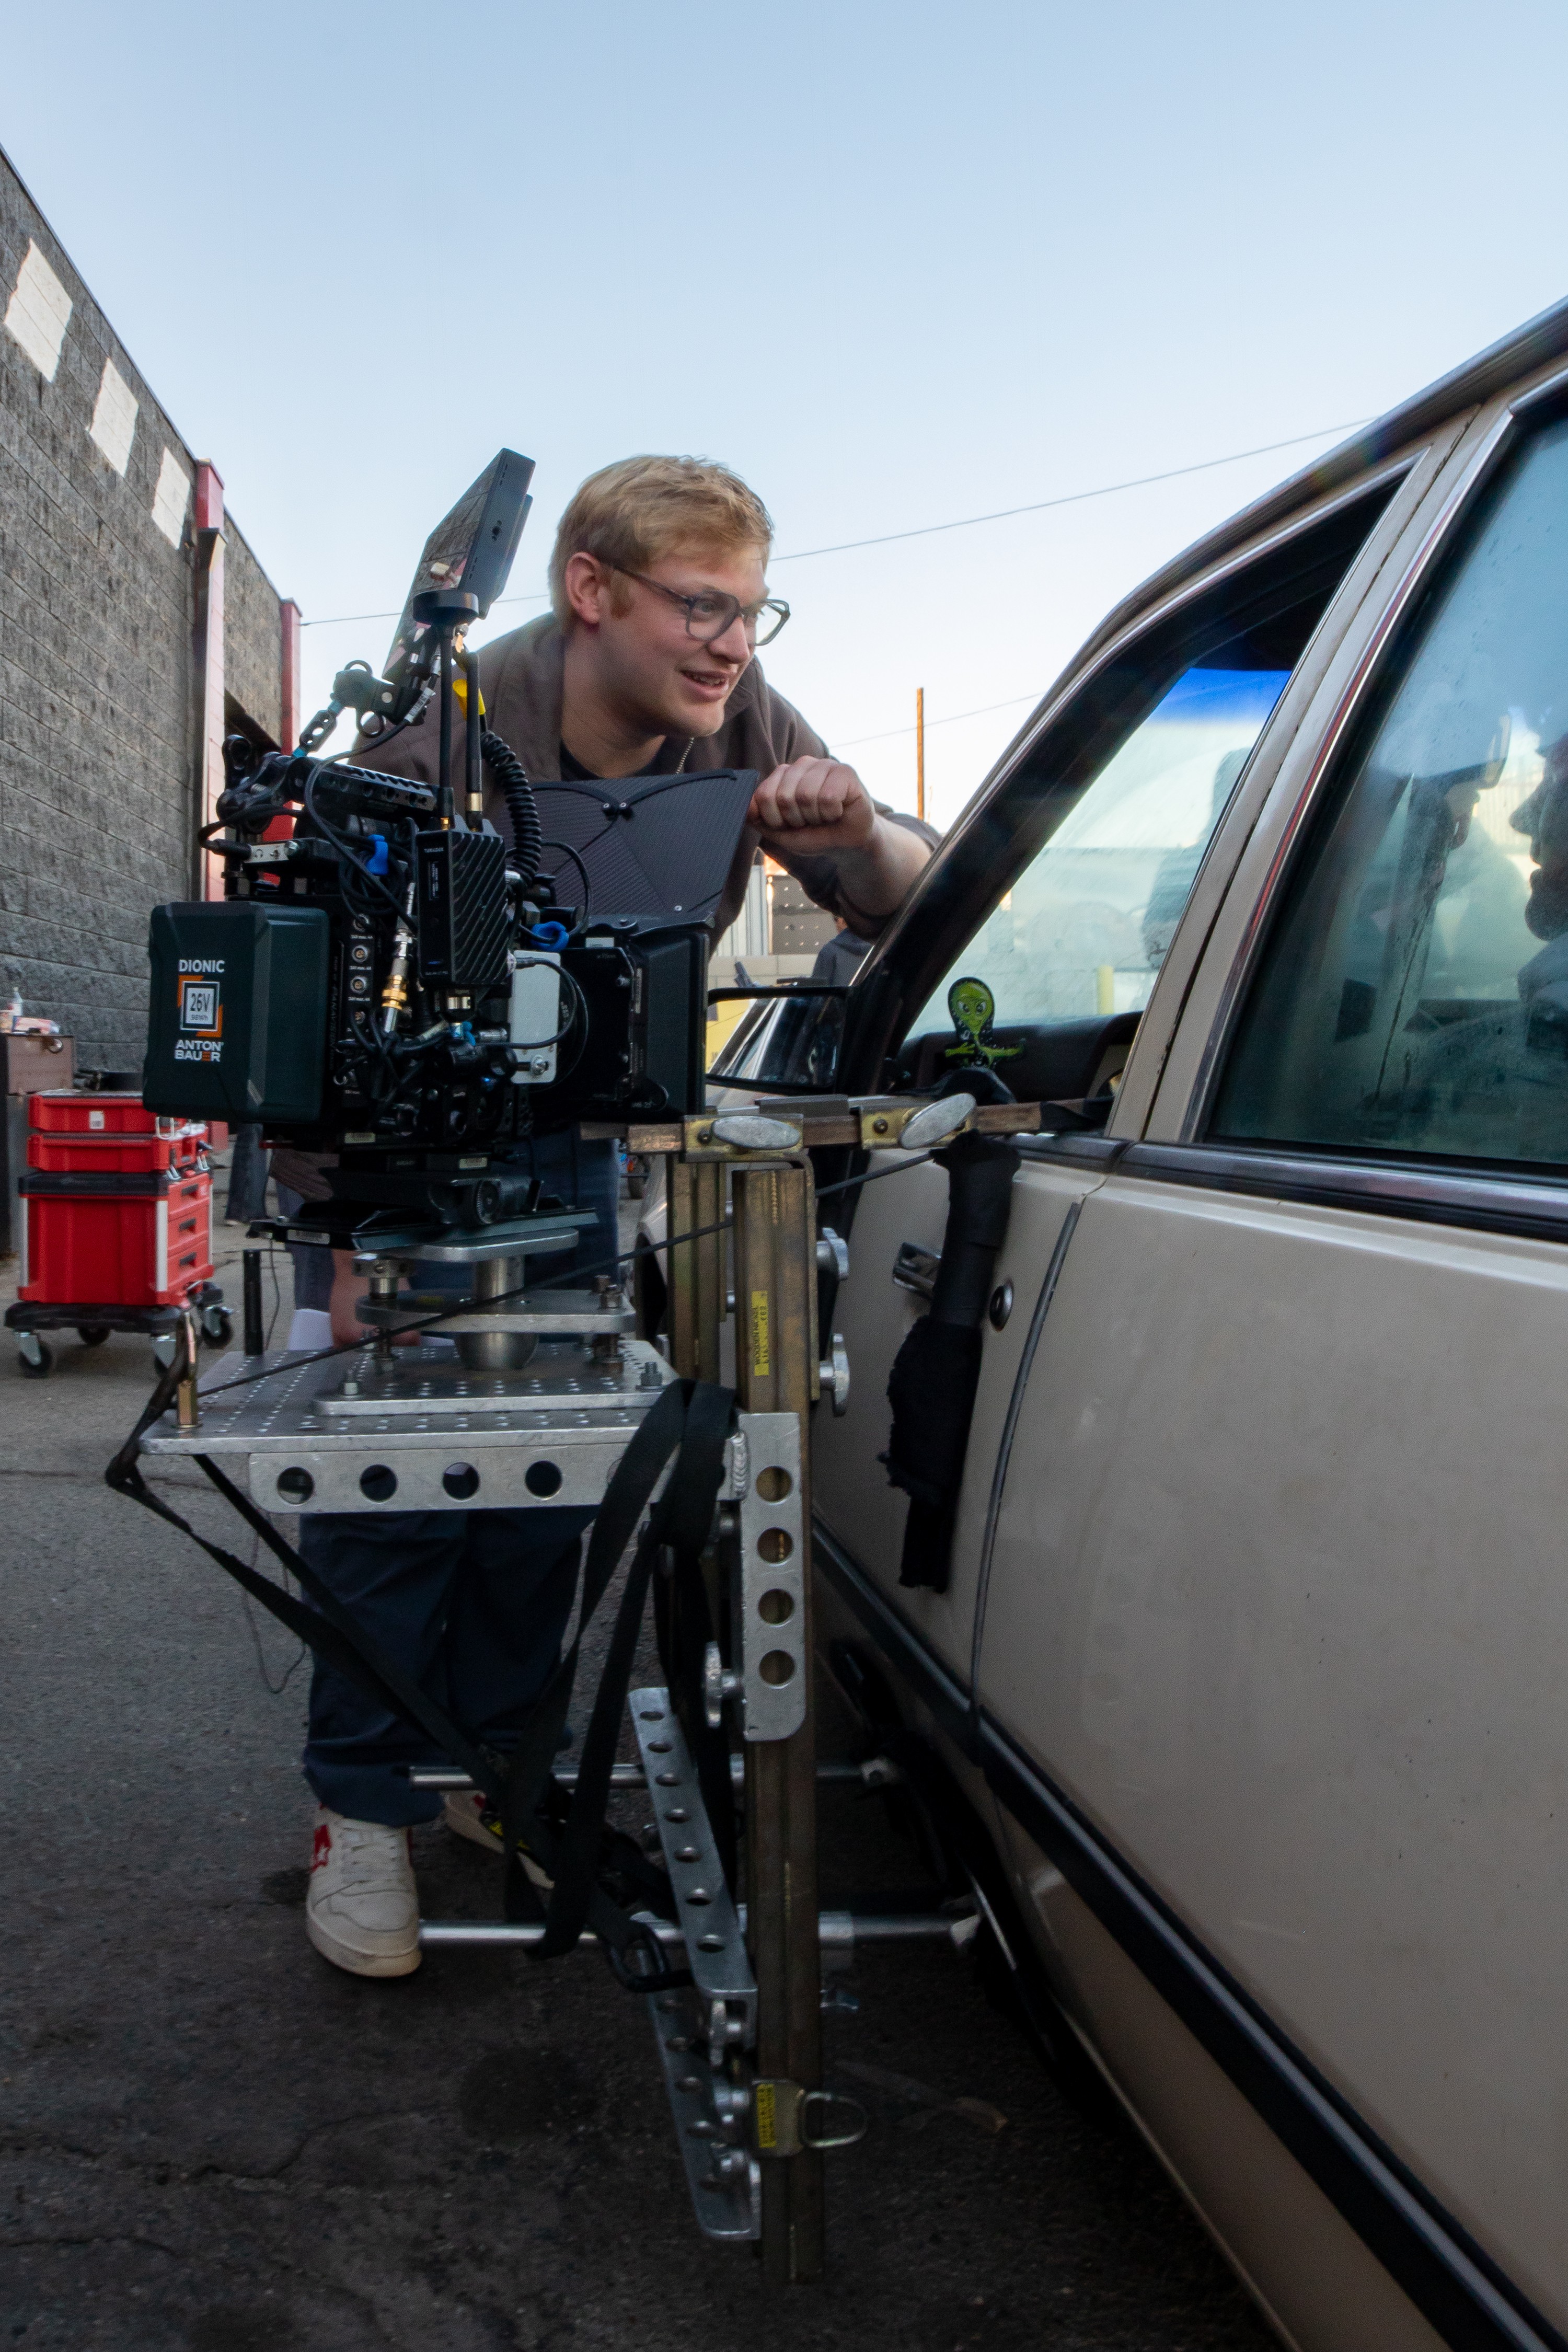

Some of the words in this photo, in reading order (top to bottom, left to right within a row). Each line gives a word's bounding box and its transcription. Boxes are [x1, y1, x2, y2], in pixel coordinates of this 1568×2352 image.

[178, 959, 225, 973] DIONIC
[190, 993, 211, 1012] 26V
[176, 1040, 222, 1052] ANTON
[175, 1050, 221, 1062] BAUER
